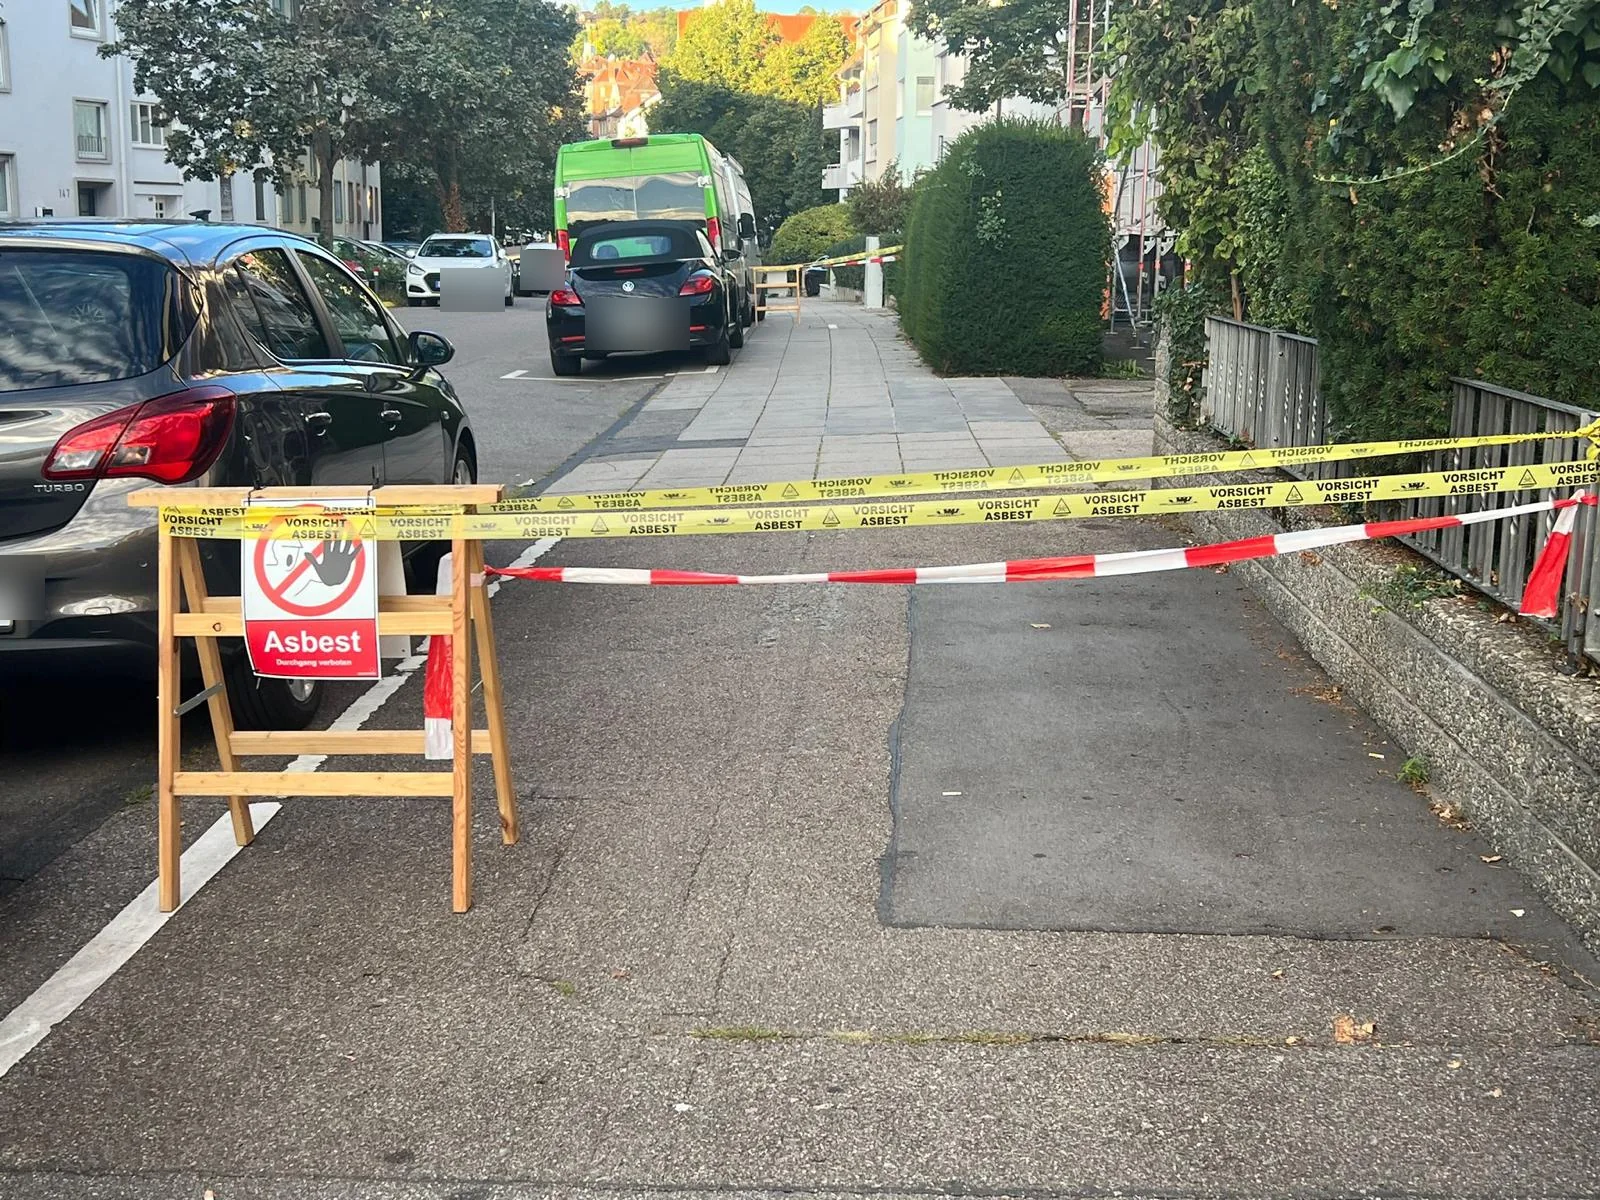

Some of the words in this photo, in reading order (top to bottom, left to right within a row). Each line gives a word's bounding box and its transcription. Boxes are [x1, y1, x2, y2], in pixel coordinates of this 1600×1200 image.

[1442, 470, 1506, 483] VORSICHT
[33, 484, 85, 492] TURBO
[1316, 480, 1380, 491] VORSICHT
[1450, 482, 1498, 494] ASBEST
[1210, 486, 1273, 498] VORSICHT
[1324, 491, 1372, 502] ASBEST
[977, 499, 1040, 510] VORSICHT
[1084, 493, 1146, 505] VORSICHT
[1217, 498, 1266, 509] ASBEST
[747, 509, 810, 520] VORSICHT
[852, 504, 915, 516] VORSICHT
[984, 510, 1033, 521] ASBEST
[1092, 505, 1140, 516] ASBEST
[162, 514, 222, 526] VORSICHT
[285, 518, 347, 528] VORSICHT
[390, 518, 452, 528] VORSICHT
[514, 516, 578, 526] VORSICHT
[622, 513, 684, 524] VORSICHT
[860, 516, 908, 526] ASBEST
[629, 524, 678, 534] ASBEST
[754, 520, 802, 531] ASBEST
[169, 526, 216, 537] ASBEST
[292, 530, 339, 539] ASBEST
[396, 530, 445, 539] ASBEST
[522, 528, 570, 537] ASBEST
[264, 630, 362, 653] Asbest
[276, 659, 317, 667] Durchgang
